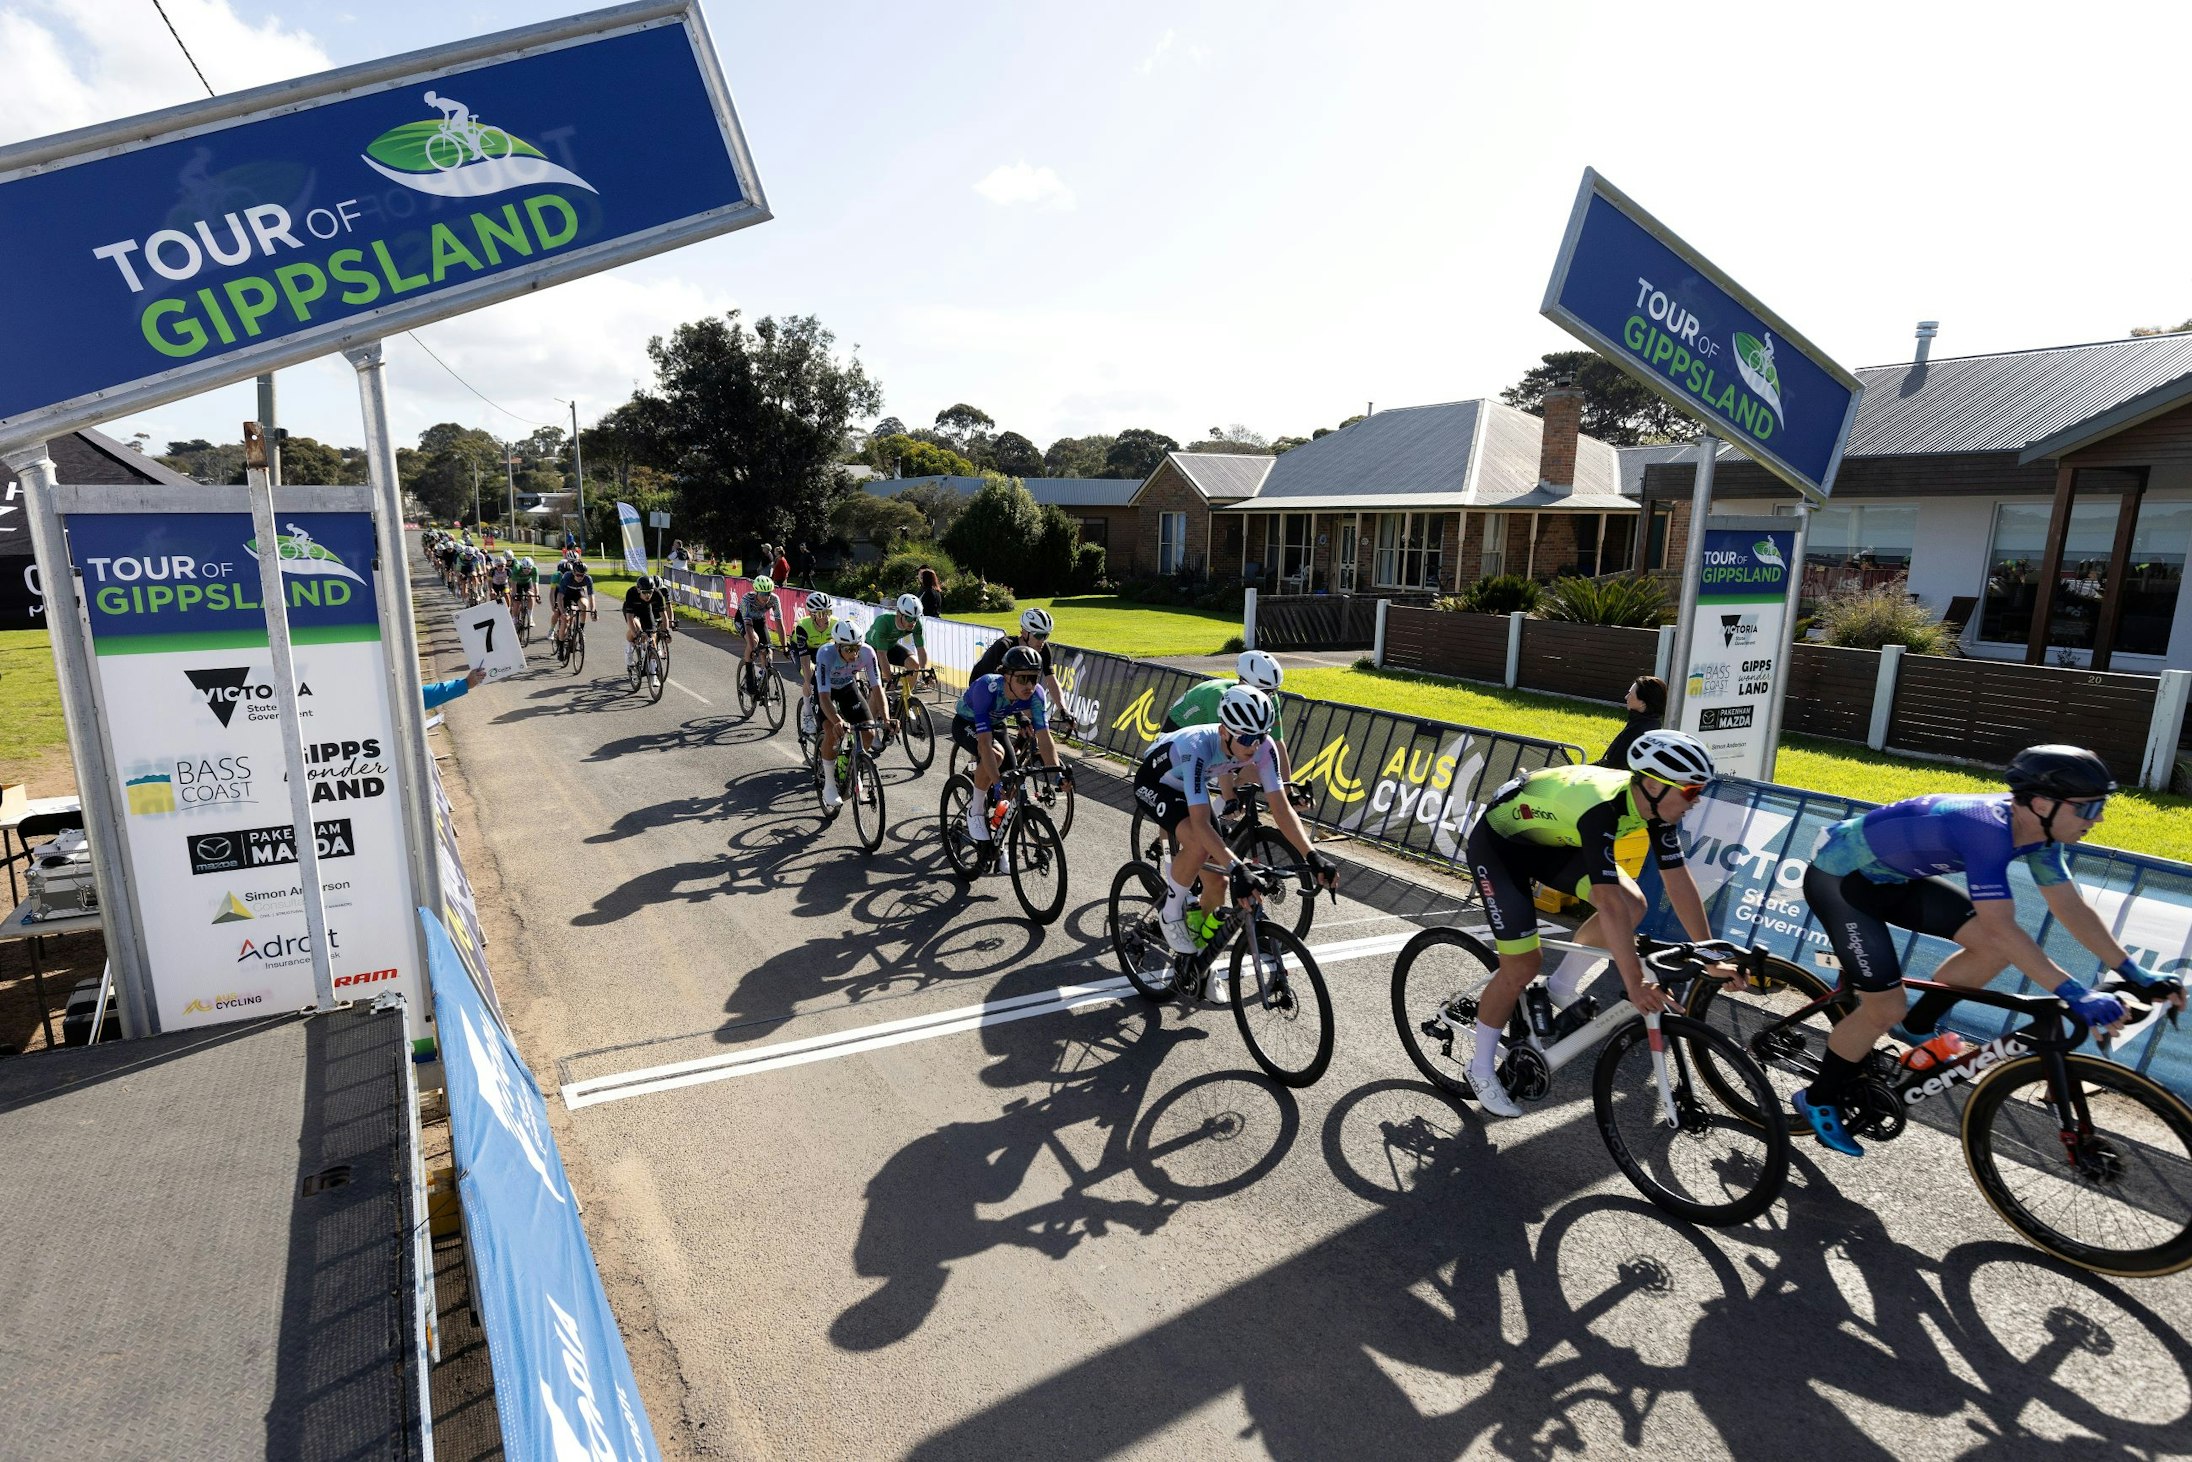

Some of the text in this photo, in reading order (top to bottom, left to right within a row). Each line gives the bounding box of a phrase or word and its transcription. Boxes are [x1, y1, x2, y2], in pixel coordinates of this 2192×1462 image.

[92, 199, 361, 293] TOUR OF
[141, 194, 578, 357] GIPPSLAND
[1636, 277, 1720, 359] TOUR OF
[1624, 315, 1774, 440] GIPPSLAND
[87, 556, 233, 581] TOUR OF
[1704, 551, 1748, 565] TOUR OF
[1702, 567, 1782, 583] GIPPSLAND
[473, 618, 495, 653] 7
[1723, 624, 1758, 635] VICTORIA
[1706, 665, 1731, 680] BASS
[1738, 670, 1772, 682] wonder
[1742, 659, 1772, 672] GIPPS
[1704, 680, 1729, 691] COAST
[1739, 682, 1768, 696] LAND
[2088, 675, 2102, 684] 20
[197, 682, 313, 703] VICTOA
[247, 704, 277, 713] State
[248, 709, 313, 721] Goverent
[1719, 715, 1751, 728] MAZDA
[304, 738, 381, 764] IPPS
[176, 756, 252, 784] BASS
[284, 757, 389, 782] onder
[1382, 746, 1456, 790] AUS
[181, 781, 253, 803] COAST
[312, 777, 385, 803] AND
[1372, 779, 1487, 834] CYCLI
[250, 822, 341, 844] PAKEAM
[252, 838, 350, 865] MADA
[1681, 829, 1808, 889] VICTO
[245, 887, 287, 902] Simon
[1741, 888, 1800, 918] State
[237, 928, 340, 962] Adrot
[1845, 922, 1874, 978] BridgeLane
[265, 956, 312, 970] Insurance
[334, 968, 398, 988] RAM
[215, 992, 238, 1002] AUS
[215, 995, 262, 1011] CYCLING
[1904, 1038, 2029, 1106] cervélo
